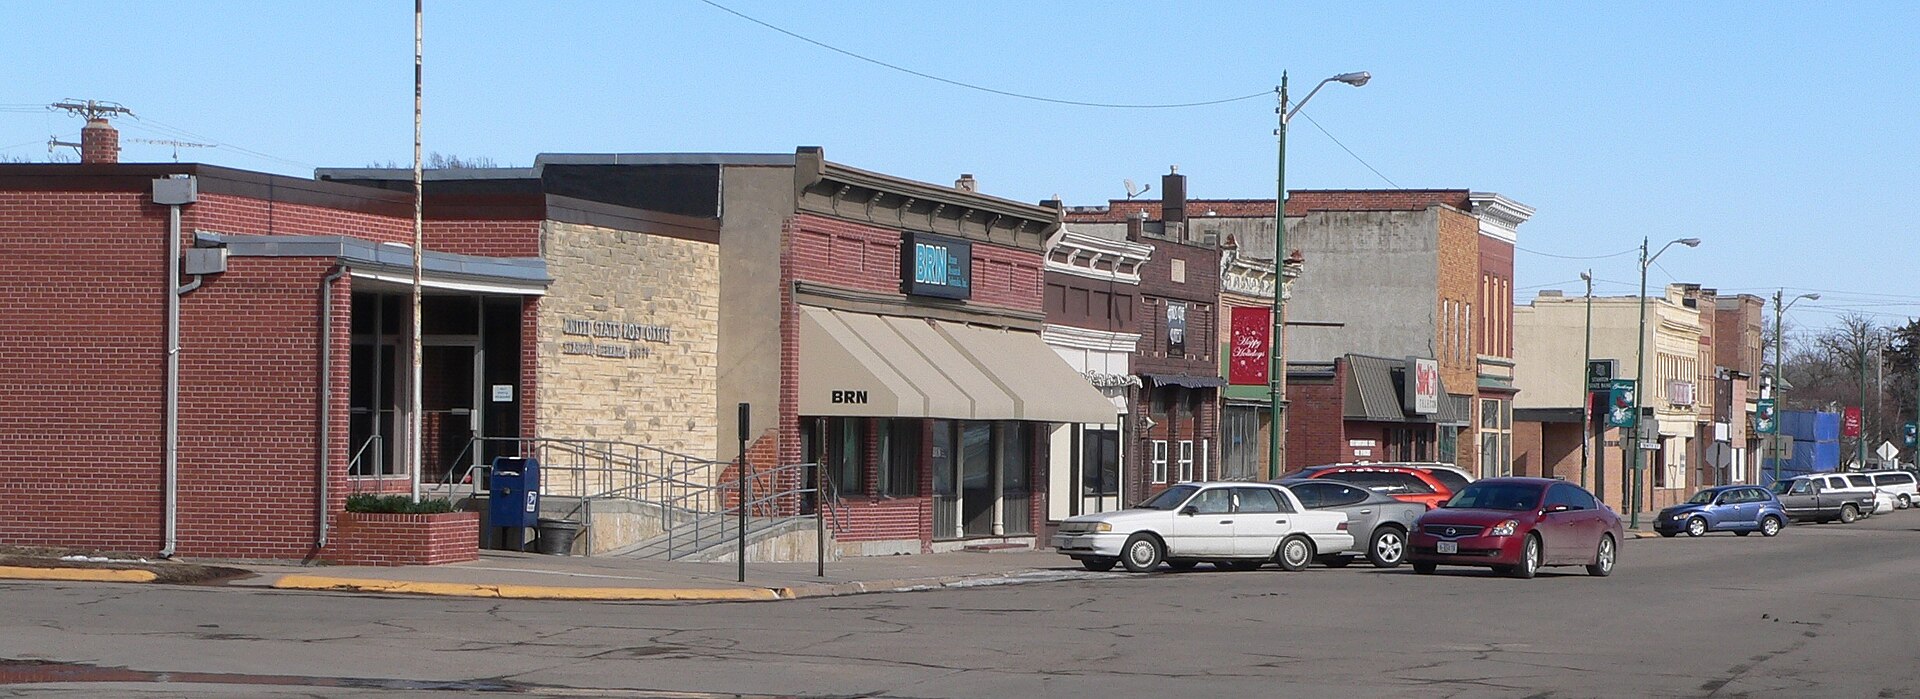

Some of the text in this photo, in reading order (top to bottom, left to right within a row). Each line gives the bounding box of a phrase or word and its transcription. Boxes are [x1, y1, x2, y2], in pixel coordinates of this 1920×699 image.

[915, 243, 947, 286] BRN
[622, 323, 643, 341] POST
[1237, 335, 1262, 348] Happy
[1232, 347, 1265, 360] Holidays
[832, 390, 868, 404] BRN
